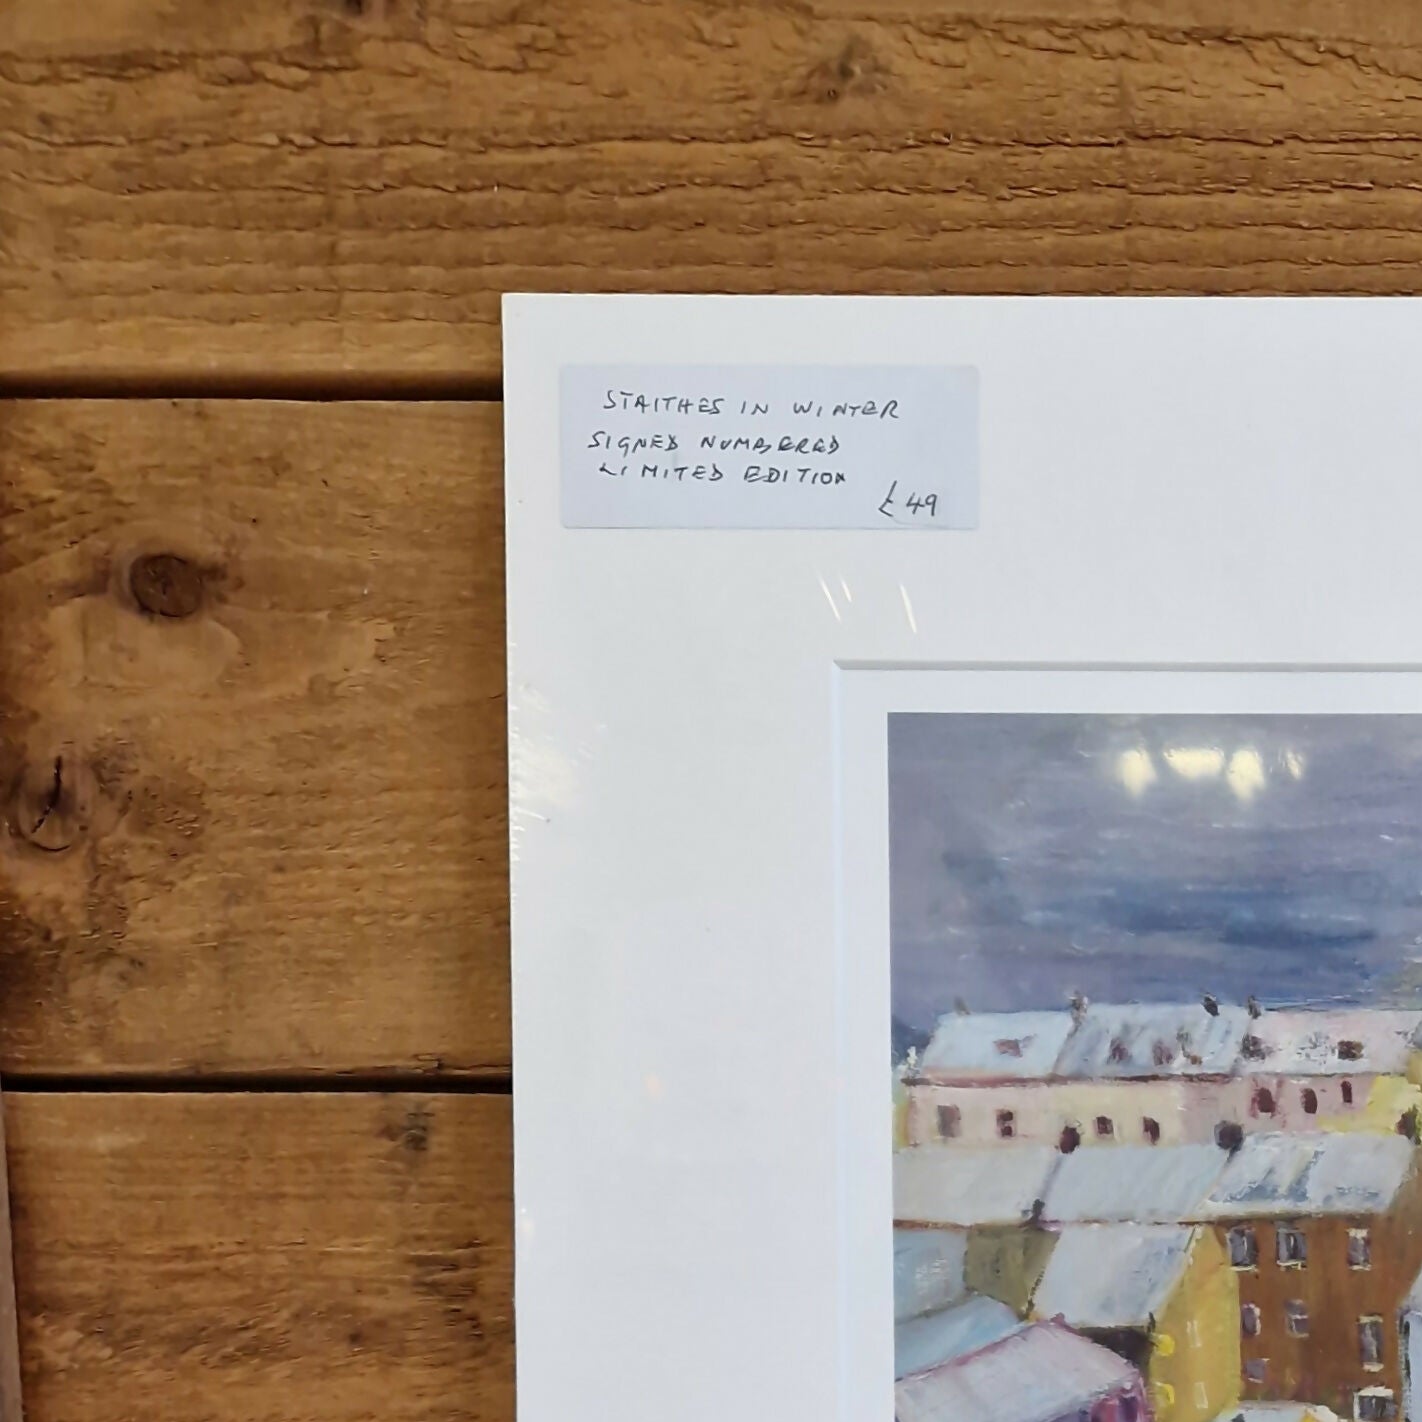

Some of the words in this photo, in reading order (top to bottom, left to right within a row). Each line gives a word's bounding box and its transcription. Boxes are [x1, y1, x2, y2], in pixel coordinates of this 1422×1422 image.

[603, 389, 725, 415] STAITHES
[740, 400, 769, 415] IN
[793, 399, 900, 419] WINTER
[587, 430, 679, 457] SIGNED
[700, 434, 840, 455] NUMBERED
[598, 462, 724, 482] LIMITED
[743, 465, 846, 485] EDITION
[878, 480, 939, 518] £49
